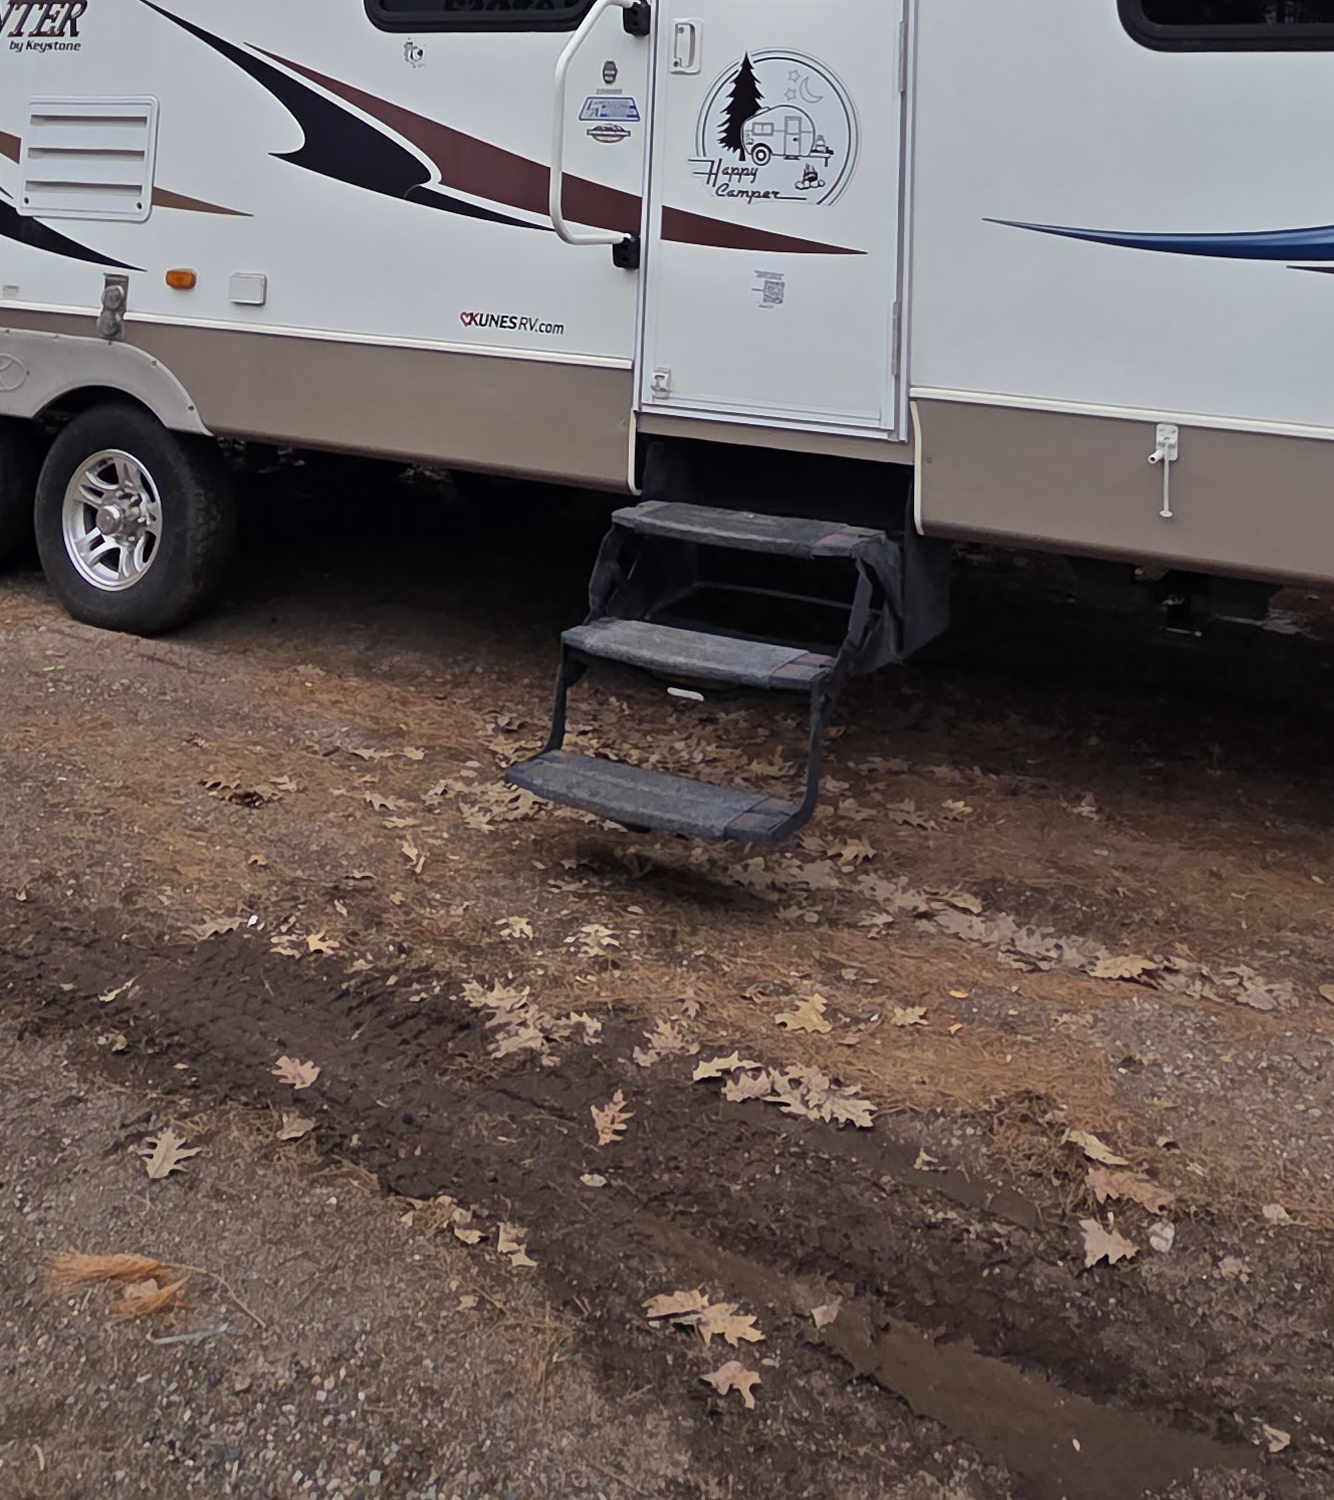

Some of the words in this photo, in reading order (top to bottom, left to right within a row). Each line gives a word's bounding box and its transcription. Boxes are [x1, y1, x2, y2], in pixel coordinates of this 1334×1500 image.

[9, 40, 24, 52] by
[25, 40, 81, 53] Keystone
[688, 158, 758, 188] Happy
[715, 182, 807, 204] Camper
